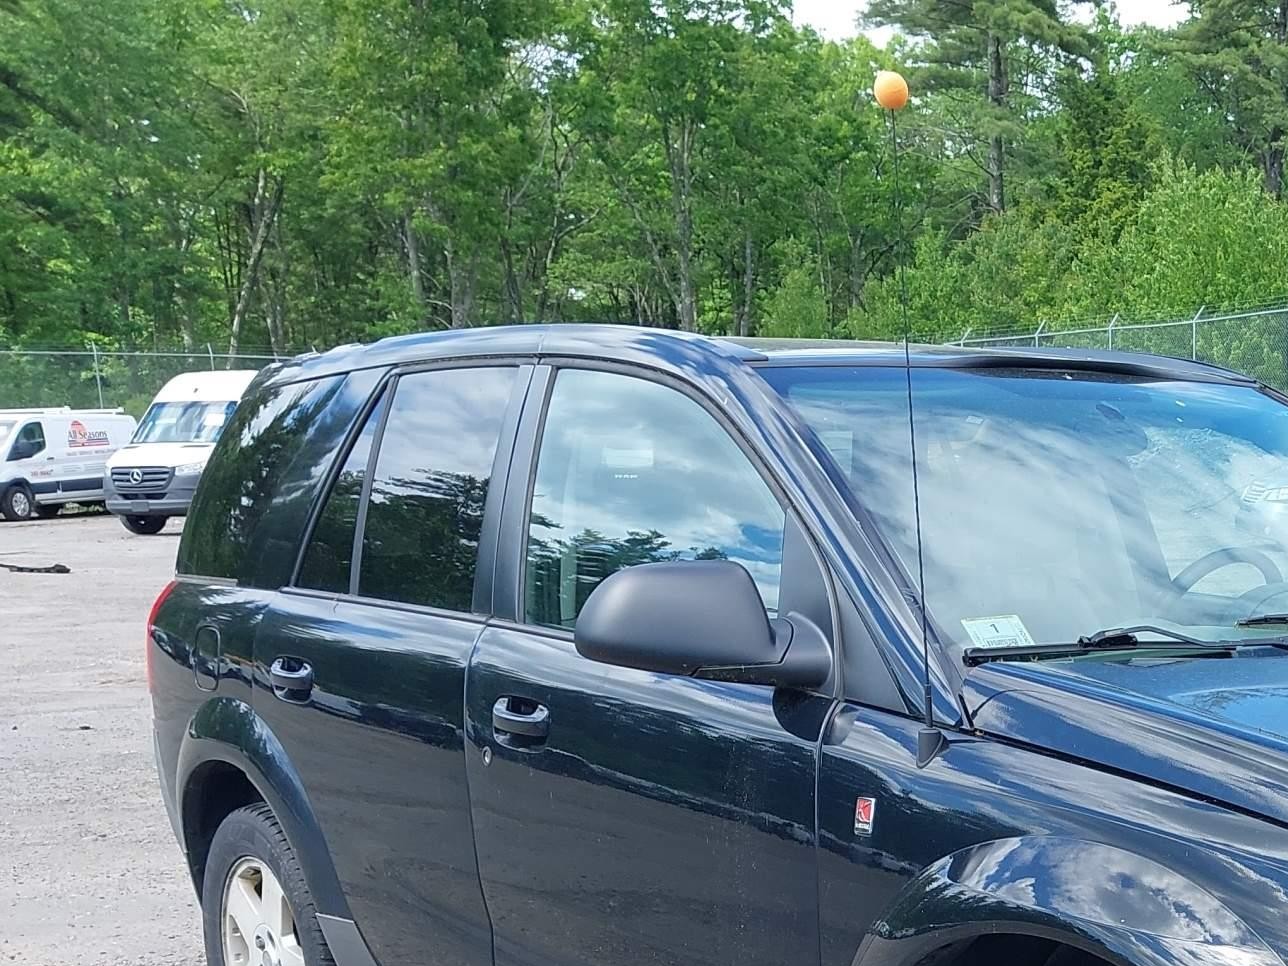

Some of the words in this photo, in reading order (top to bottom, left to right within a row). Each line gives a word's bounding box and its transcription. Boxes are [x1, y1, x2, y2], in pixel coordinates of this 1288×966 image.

[68, 429, 77, 440] All
[79, 430, 108, 440] Seasons
[989, 623, 1000, 633] 1
